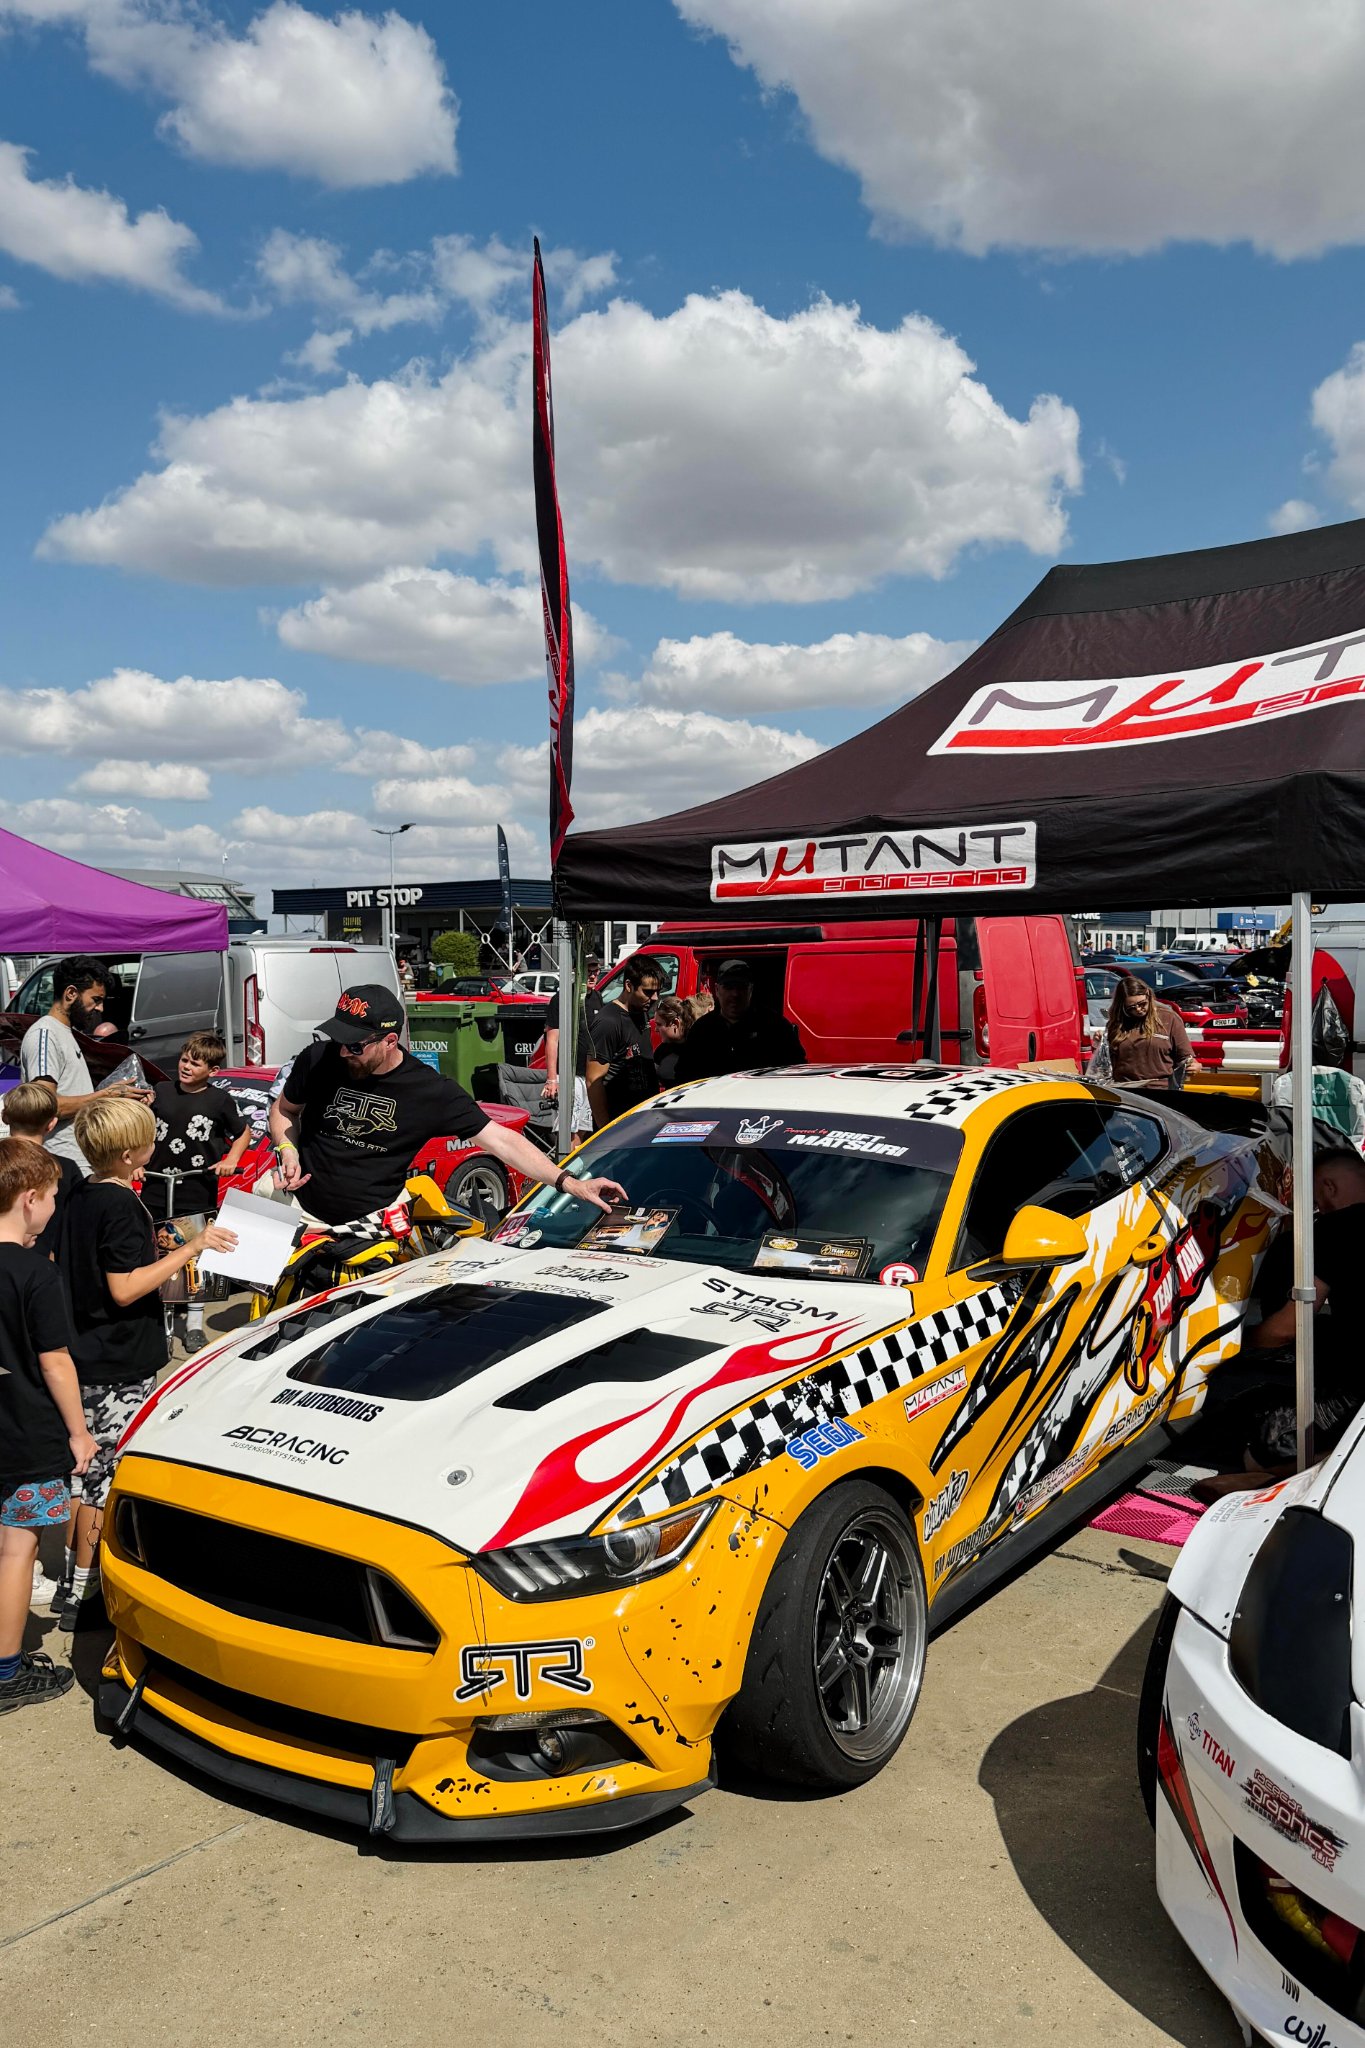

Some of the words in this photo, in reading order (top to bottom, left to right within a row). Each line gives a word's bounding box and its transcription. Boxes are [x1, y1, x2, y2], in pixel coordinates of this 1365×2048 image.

[823, 868, 1023, 892] engineering
[346, 890, 373, 907] PIT
[376, 888, 423, 906] STOP
[409, 1040, 449, 1053] RUNDON
[514, 1043, 537, 1054] GRU
[446, 1139, 477, 1152] MA
[787, 1134, 909, 1157] MATSURI
[826, 1130, 885, 1143] DRIFT
[702, 1277, 839, 1321] STRÖM
[726, 1300, 791, 1317] WHEELS
[270, 1389, 303, 1405] BM
[294, 1391, 385, 1422] AUTOBODIES
[230, 1441, 273, 1455] SUSPENSION
[273, 1450, 308, 1465] SYSTEMS
[785, 1416, 868, 1473] SEGA
[1187, 1715, 1202, 1738] FUCHS
[1202, 1729, 1236, 1779] TITAN
[1251, 1782, 1338, 1859] graphics
[1284, 2014, 1345, 2048] wil
